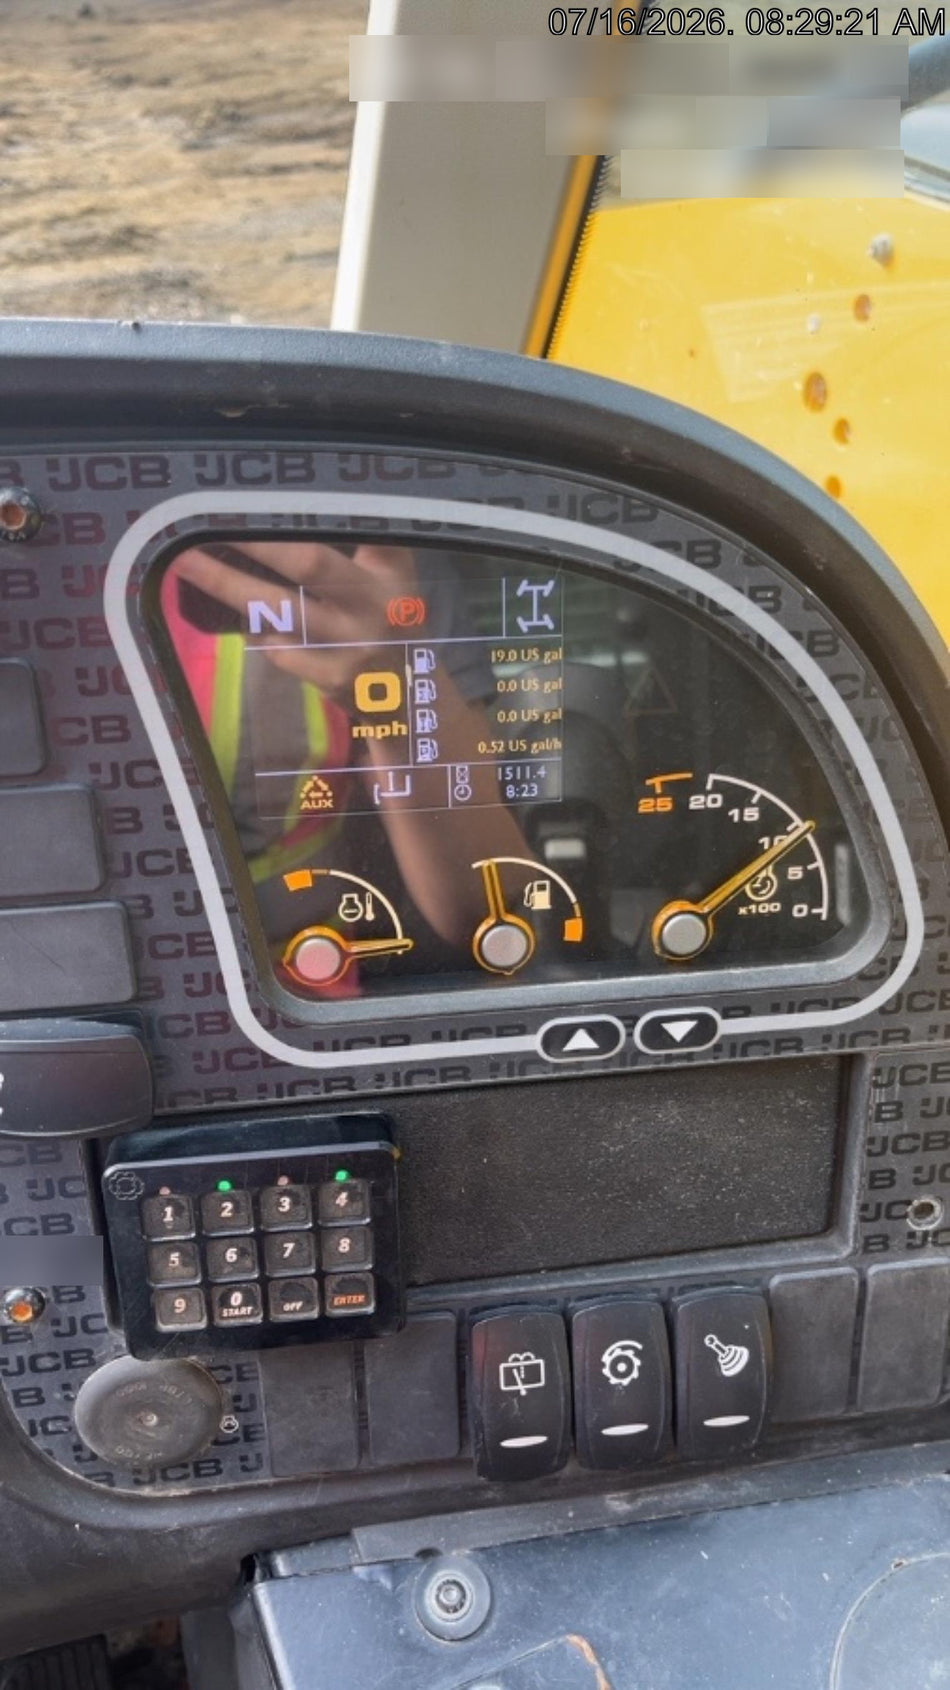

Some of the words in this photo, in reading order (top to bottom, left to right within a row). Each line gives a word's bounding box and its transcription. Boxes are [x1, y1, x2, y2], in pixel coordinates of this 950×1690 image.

[46, 456, 172, 491] JCB
[194, 453, 315, 487] JCB
[247, 599, 293, 633] N
[490, 648, 517, 663] 19.0
[520, 648, 540, 662] US
[543, 647, 563, 664] gal
[353, 671, 402, 713] 0
[496, 679, 517, 694] 0.0
[520, 678, 540, 693] US
[543, 678, 563, 695] gal
[496, 709, 517, 724] 0.0
[520, 708, 540, 723] US
[543, 708, 563, 725] gal
[351, 720, 407, 740] mph
[477, 740, 505, 755] 0.52
[507, 739, 527, 753] US
[530, 737, 563, 754] gal/h
[497, 765, 548, 782] 1511.4
[506, 784, 539, 799] 8:23
[300, 796, 334, 810] AUX
[637, 796, 673, 813] 25
[688, 793, 723, 810] 20
[727, 806, 760, 823] 15
[787, 866, 804, 880] 5
[738, 902, 782, 916] x100
[792, 904, 808, 918] 0
[278, 1196, 291, 1213] 3
[336, 1191, 349, 1208] 4
[162, 1206, 174, 1223] 1
[220, 1201, 233, 1218] 2
[282, 1242, 296, 1259] 7
[338, 1238, 351, 1253] 8
[168, 1252, 180, 1268] 5
[225, 1247, 238, 1264] 6
[174, 1298, 186, 1314] 9
[230, 1291, 243, 1307] 0
[282, 1302, 303, 1313] OFF
[333, 1293, 365, 1306] ENTER
[221, 1305, 254, 1318] START
[132, 1457, 224, 1487] JCB
